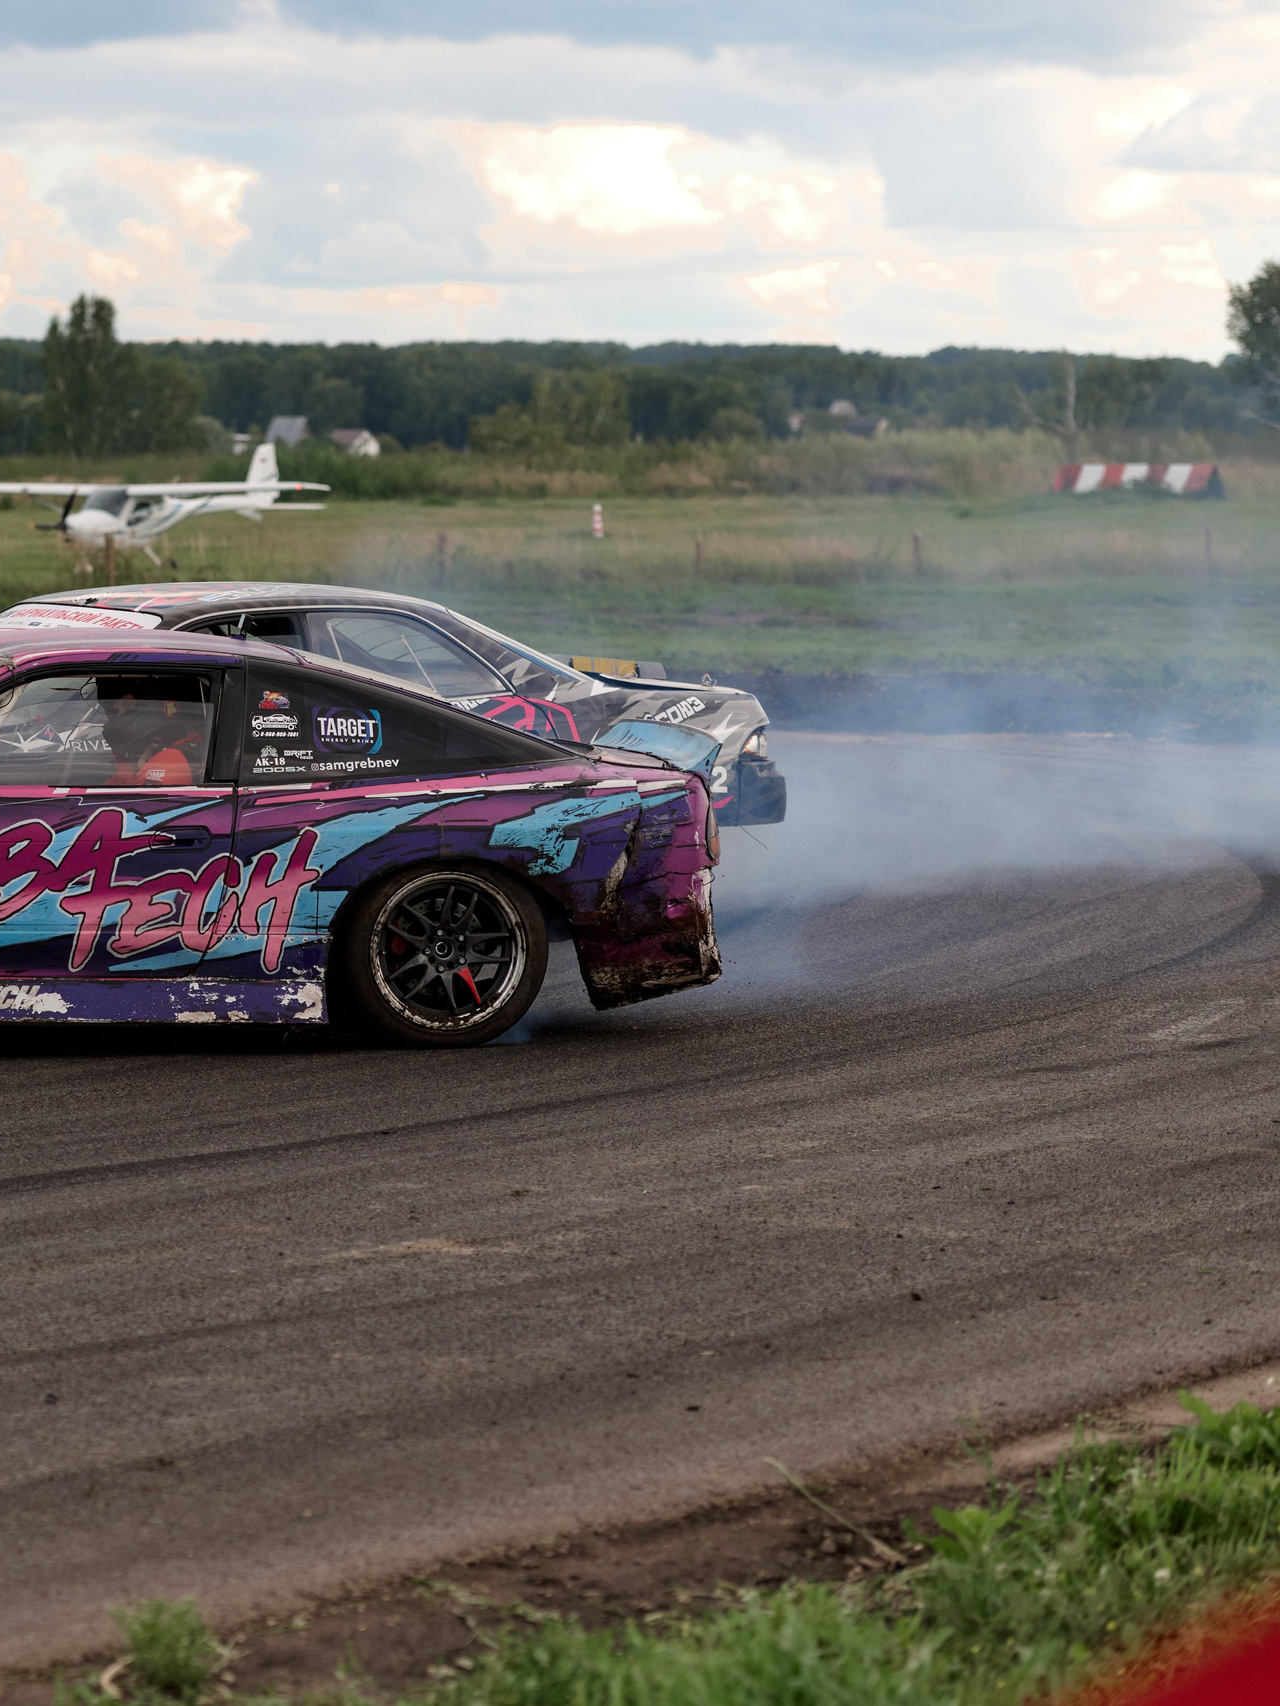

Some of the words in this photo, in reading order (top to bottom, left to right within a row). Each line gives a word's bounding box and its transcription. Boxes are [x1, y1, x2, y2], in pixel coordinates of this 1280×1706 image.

[317, 717, 376, 738] TARGET
[255, 757, 286, 766] AK-18
[253, 766, 307, 774] 200SX
[59, 826, 324, 975] TECH
